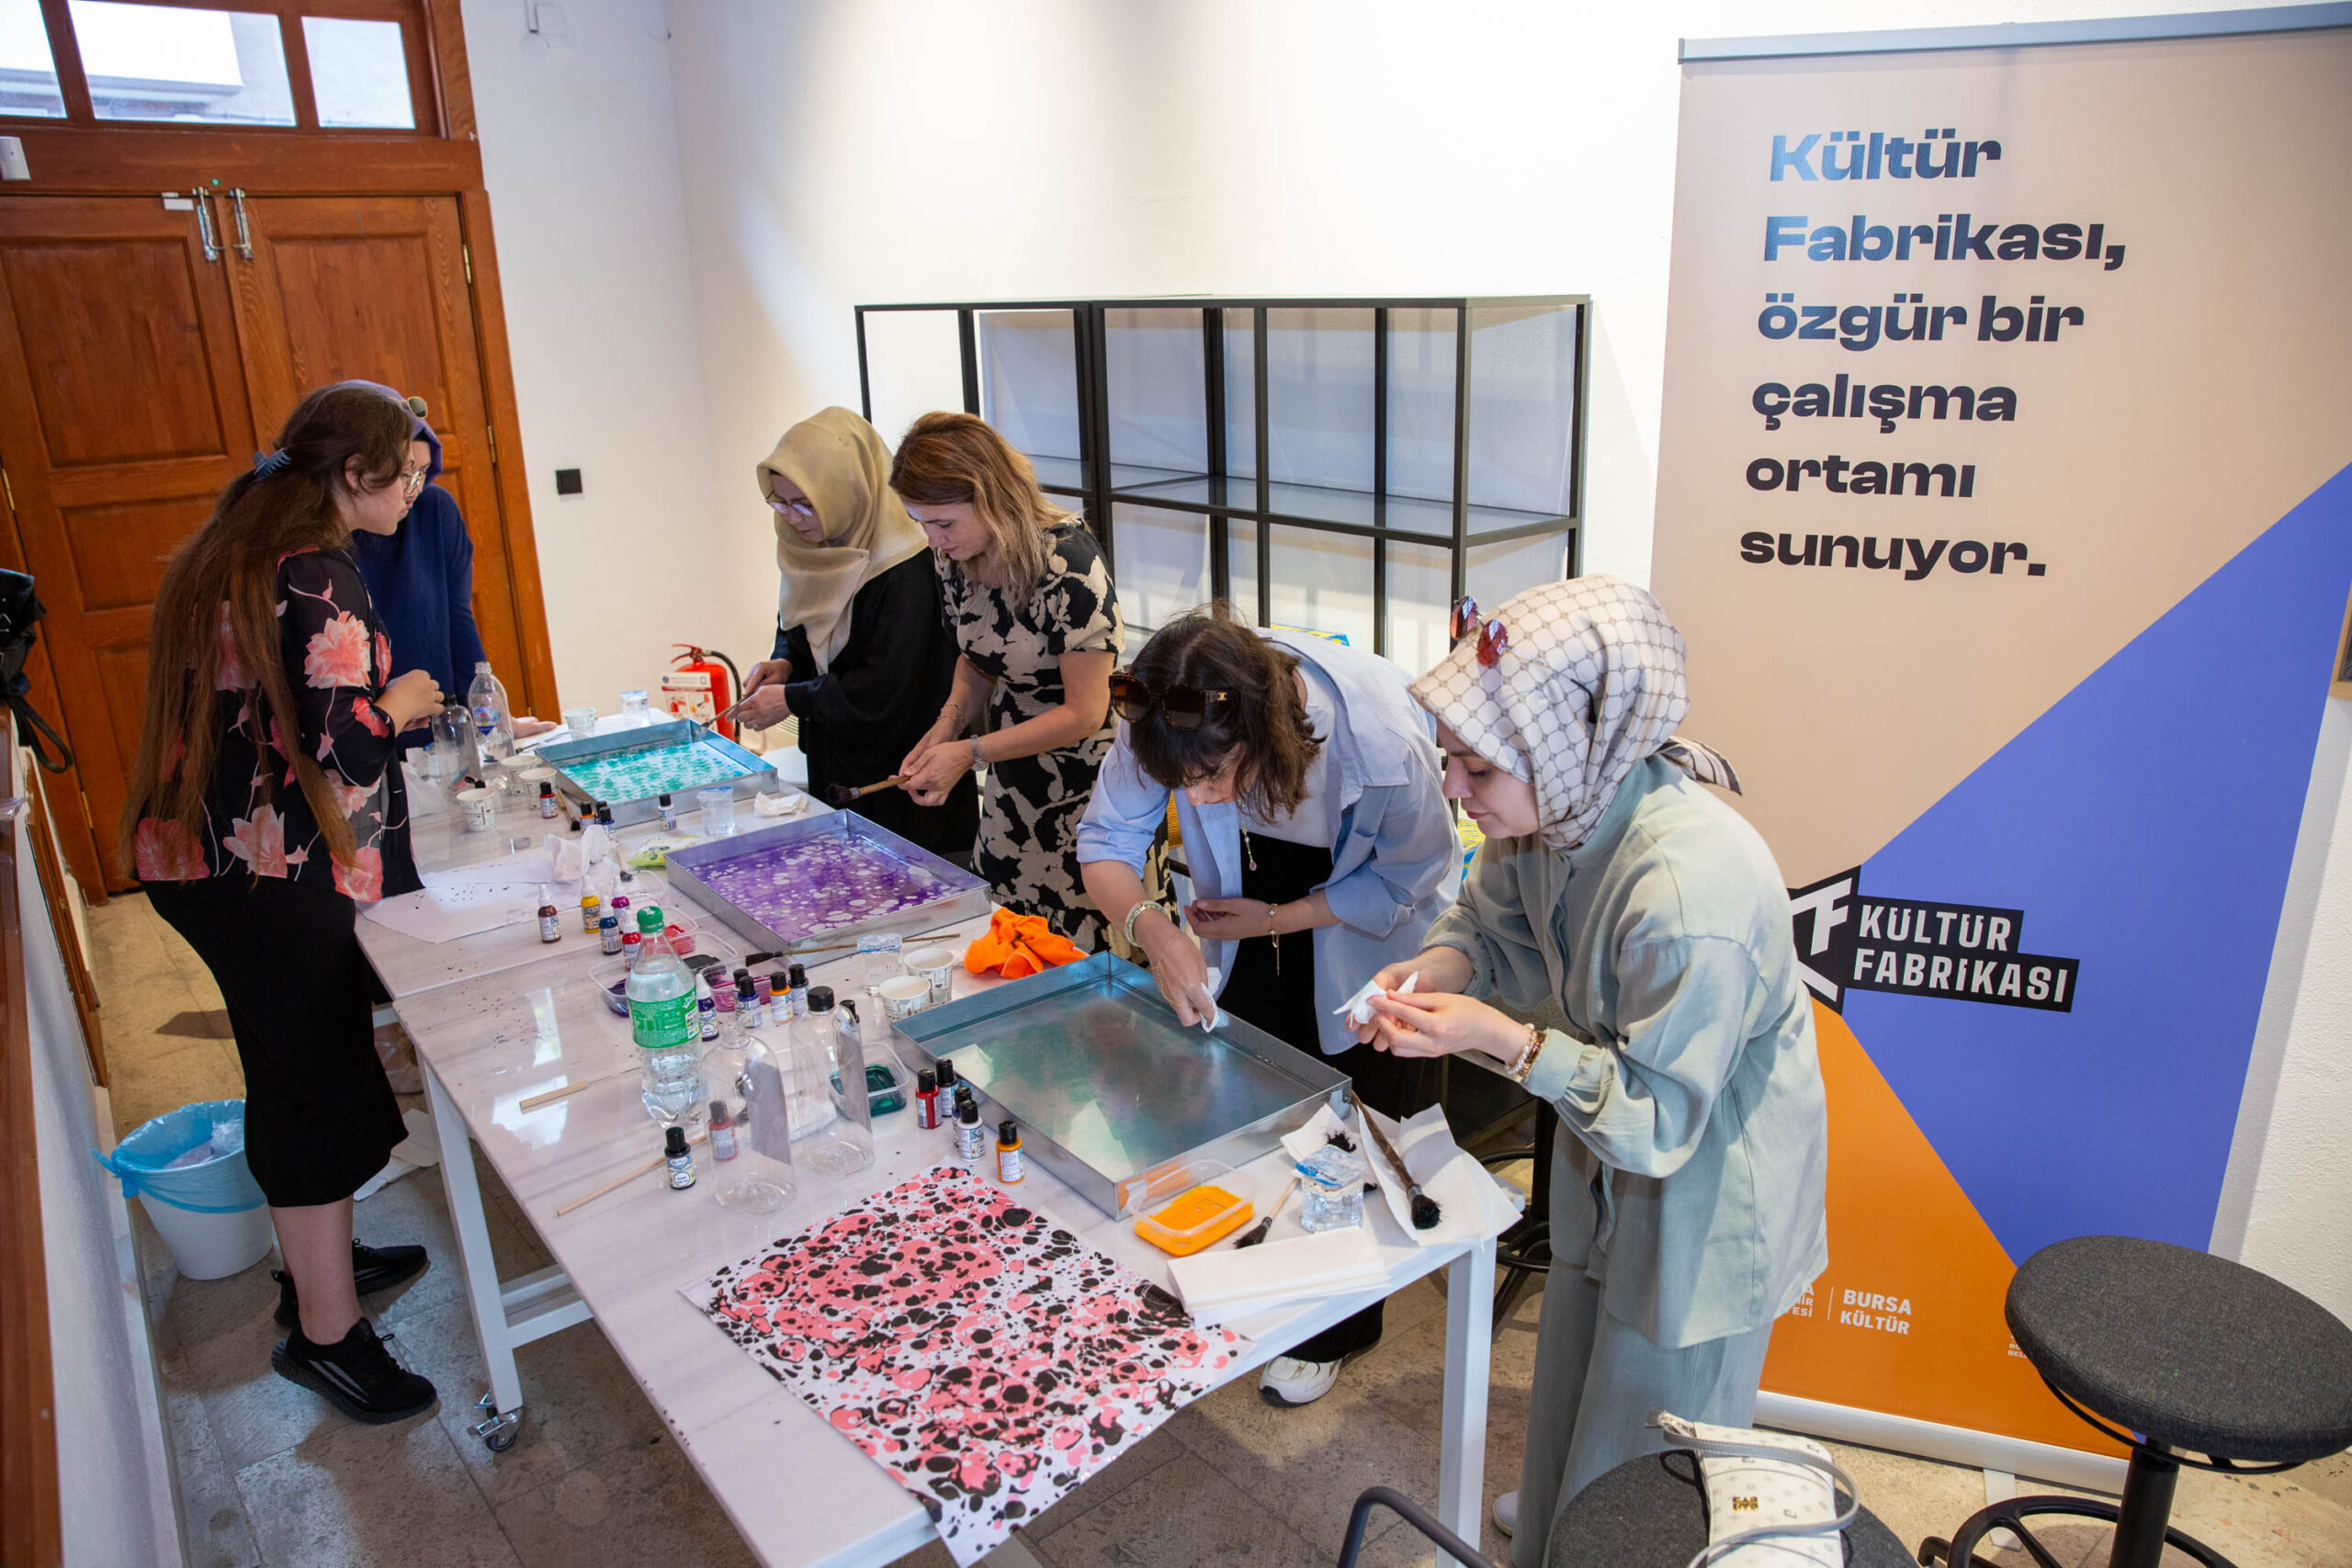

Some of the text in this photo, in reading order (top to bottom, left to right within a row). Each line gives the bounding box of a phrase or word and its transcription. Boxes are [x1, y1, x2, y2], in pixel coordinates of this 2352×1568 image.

[1770, 128, 2002, 182] Kültür
[1763, 213, 2126, 271] Fabrikası,
[1758, 292, 2085, 352] özgür bir
[1752, 373, 2018, 434] çalışma
[1746, 455, 1976, 498] ortamı
[1740, 531, 2047, 581] sunuyor.
[1859, 904, 2011, 952] KÜLTÜR
[1853, 948, 2067, 1003] FABRİKASI
[1839, 1309, 1911, 1335] KÜLTÜR
[1842, 1289, 1912, 1315] BURSA
